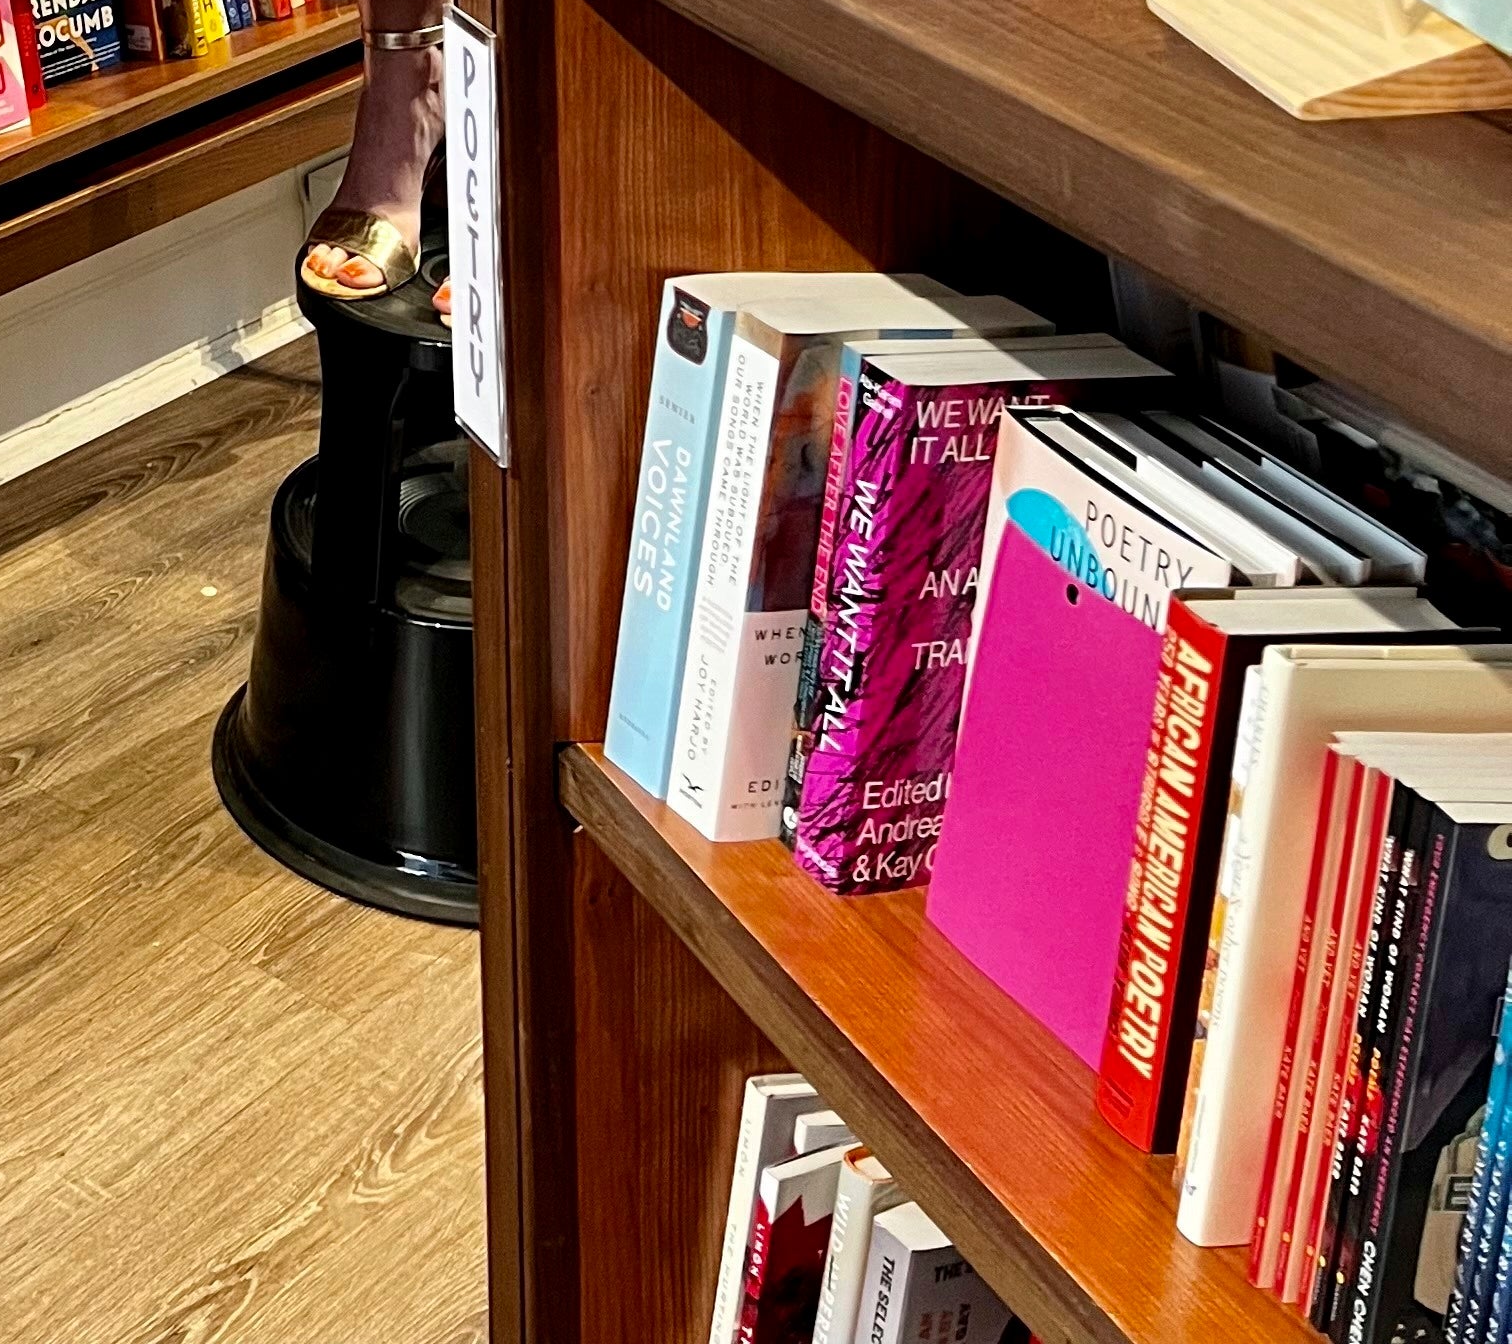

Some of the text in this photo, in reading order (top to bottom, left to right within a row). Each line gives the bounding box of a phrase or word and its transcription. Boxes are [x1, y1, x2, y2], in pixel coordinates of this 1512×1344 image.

[463, 46, 485, 398] POETRY
[910, 435, 990, 465] IT ALL
[915, 400, 964, 430] WE
[707, 354, 745, 586] OUR SONGS CAME THROUGH
[632, 438, 673, 600] VOICES
[657, 446, 693, 613] DAWNLAND
[1086, 500, 1196, 591] POETRY
[688, 653, 711, 762] JOY HARJO
[1160, 638, 1212, 798] AFRICAN
[856, 811, 945, 846] Andrea
[863, 774, 943, 810] Edited
[1117, 787, 1191, 1080] AMERICAN POETRY
[1390, 903, 1404, 942] KIND
[1375, 969, 1396, 1034] WOMAN
[832, 1192, 851, 1255] WILD
[1356, 1239, 1377, 1299] CHEN
